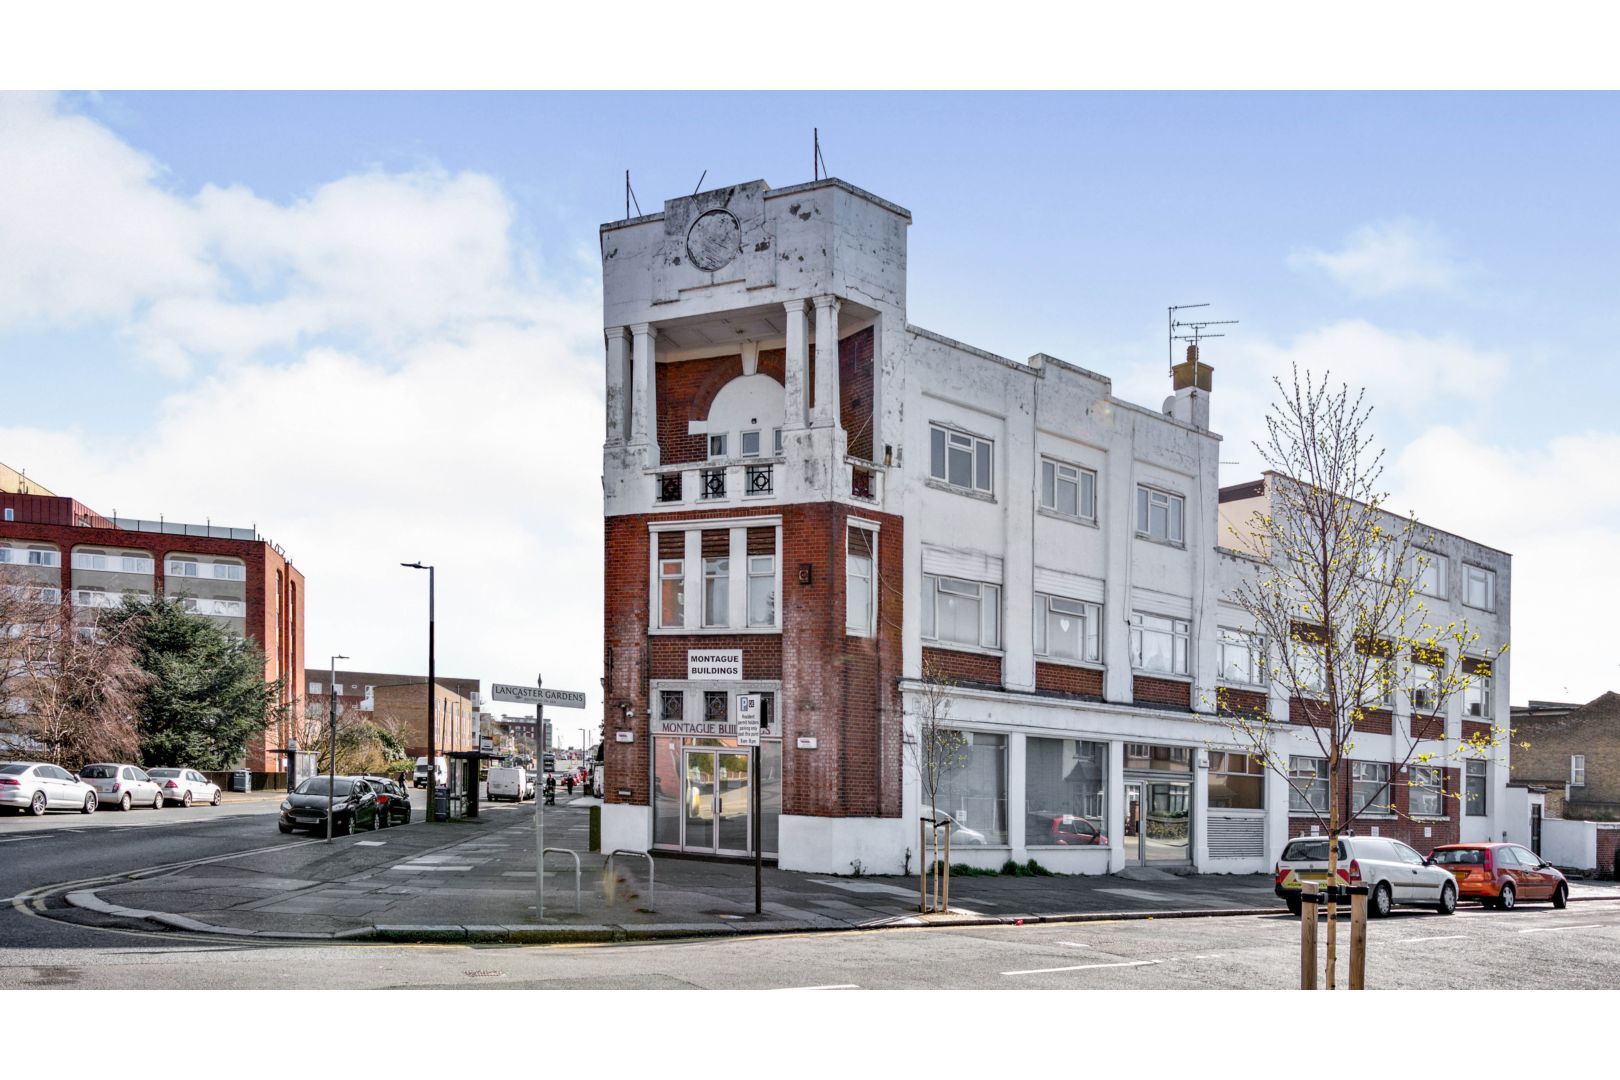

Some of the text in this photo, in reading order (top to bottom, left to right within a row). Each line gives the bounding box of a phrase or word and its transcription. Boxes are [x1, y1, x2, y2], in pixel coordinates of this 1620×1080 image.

[691, 655, 739, 663] MONTAGUE
[691, 667, 738, 675] BUILDINGS
[495, 685, 543, 698] LANCASTER
[545, 692, 583, 702] GARDENS
[662, 723, 771, 735] MONTAGUE BUILS
